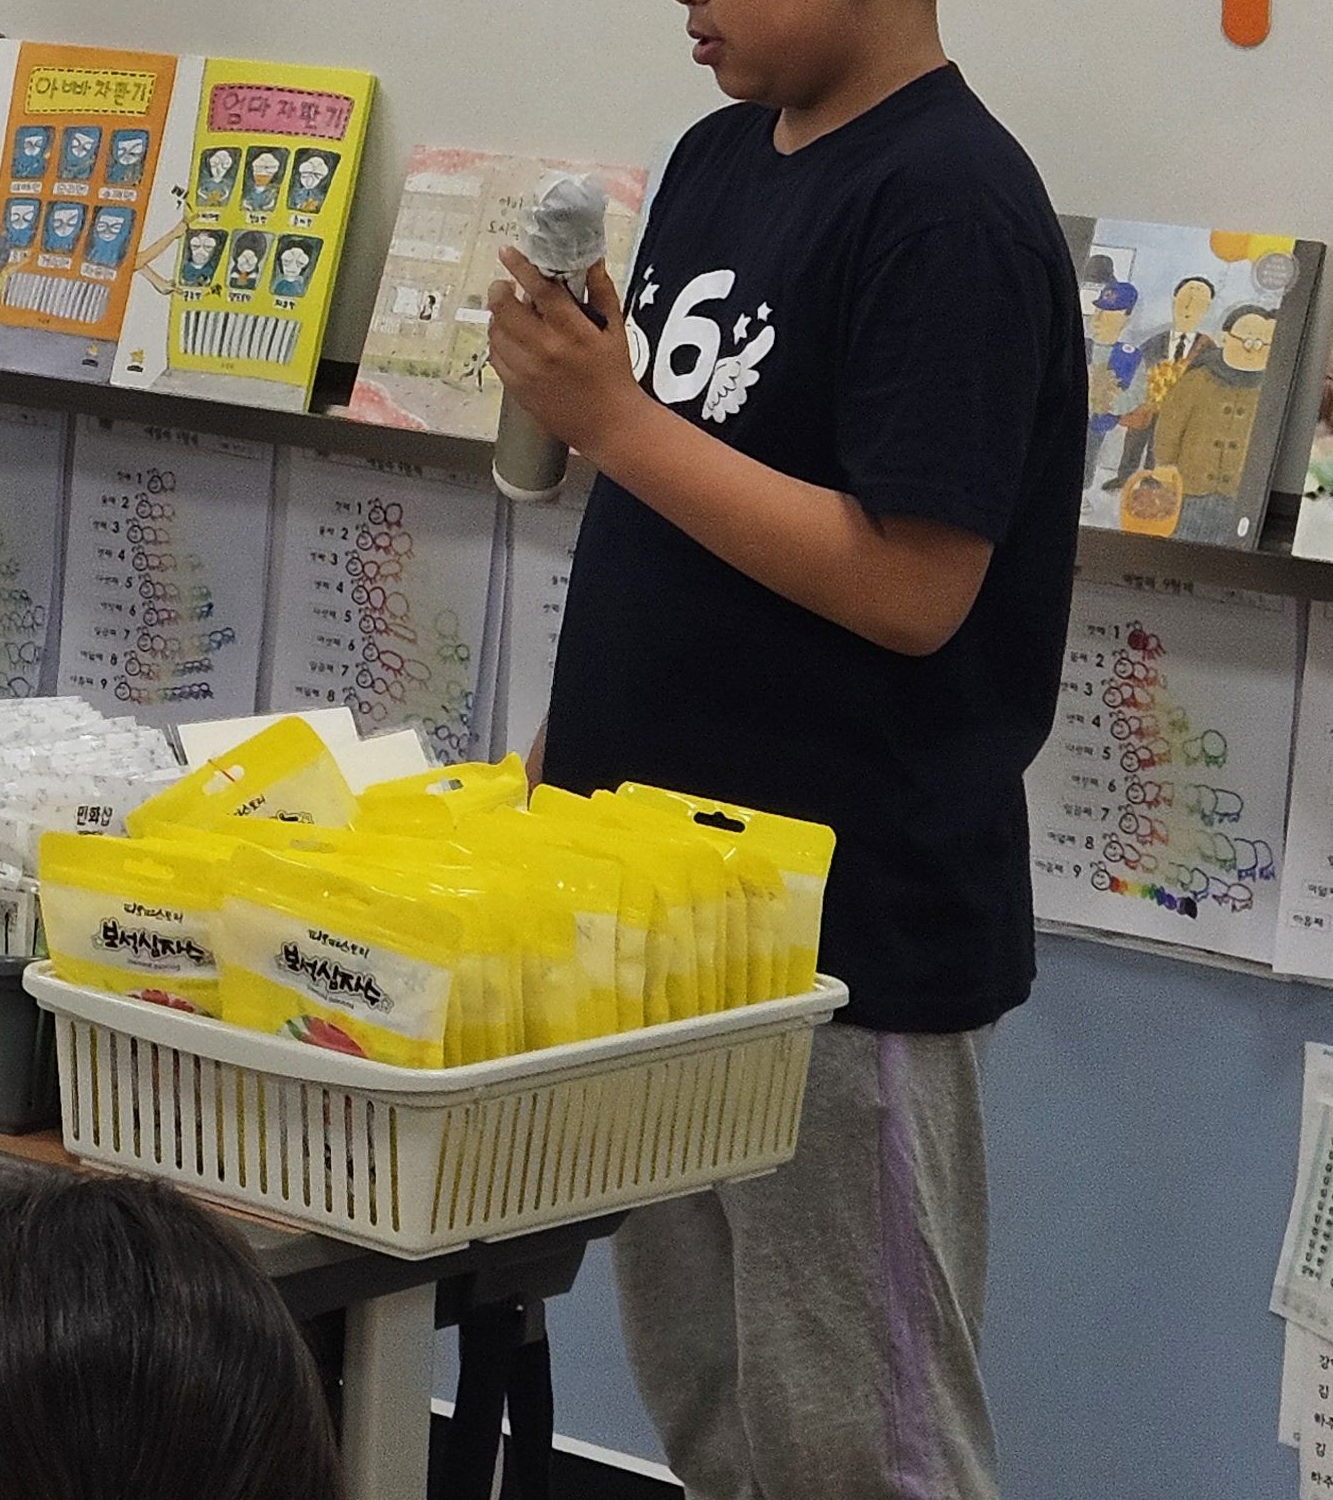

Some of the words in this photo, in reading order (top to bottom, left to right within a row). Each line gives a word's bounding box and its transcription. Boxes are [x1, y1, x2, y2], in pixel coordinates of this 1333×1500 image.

[653, 270, 735, 404] 6
[103, 920, 204, 962] 보석십자수
[284, 944, 381, 1006] 보석십자수
